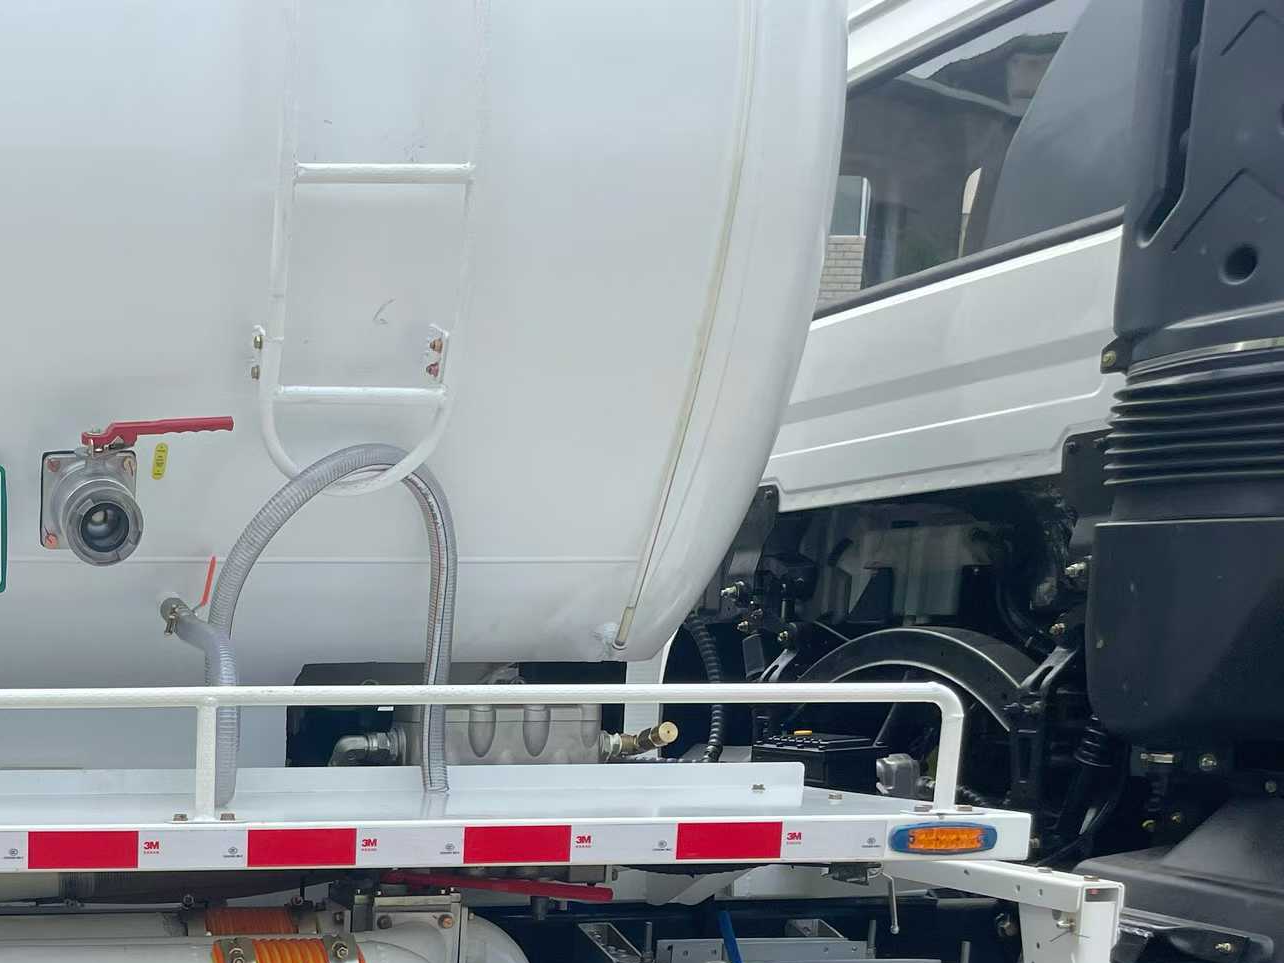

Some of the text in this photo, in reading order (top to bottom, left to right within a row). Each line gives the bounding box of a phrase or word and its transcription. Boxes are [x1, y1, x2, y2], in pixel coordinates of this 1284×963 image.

[575, 835, 591, 844] 3M
[787, 832, 802, 840] 3M
[144, 841, 160, 850] 3M
[361, 839, 377, 847] 3M
